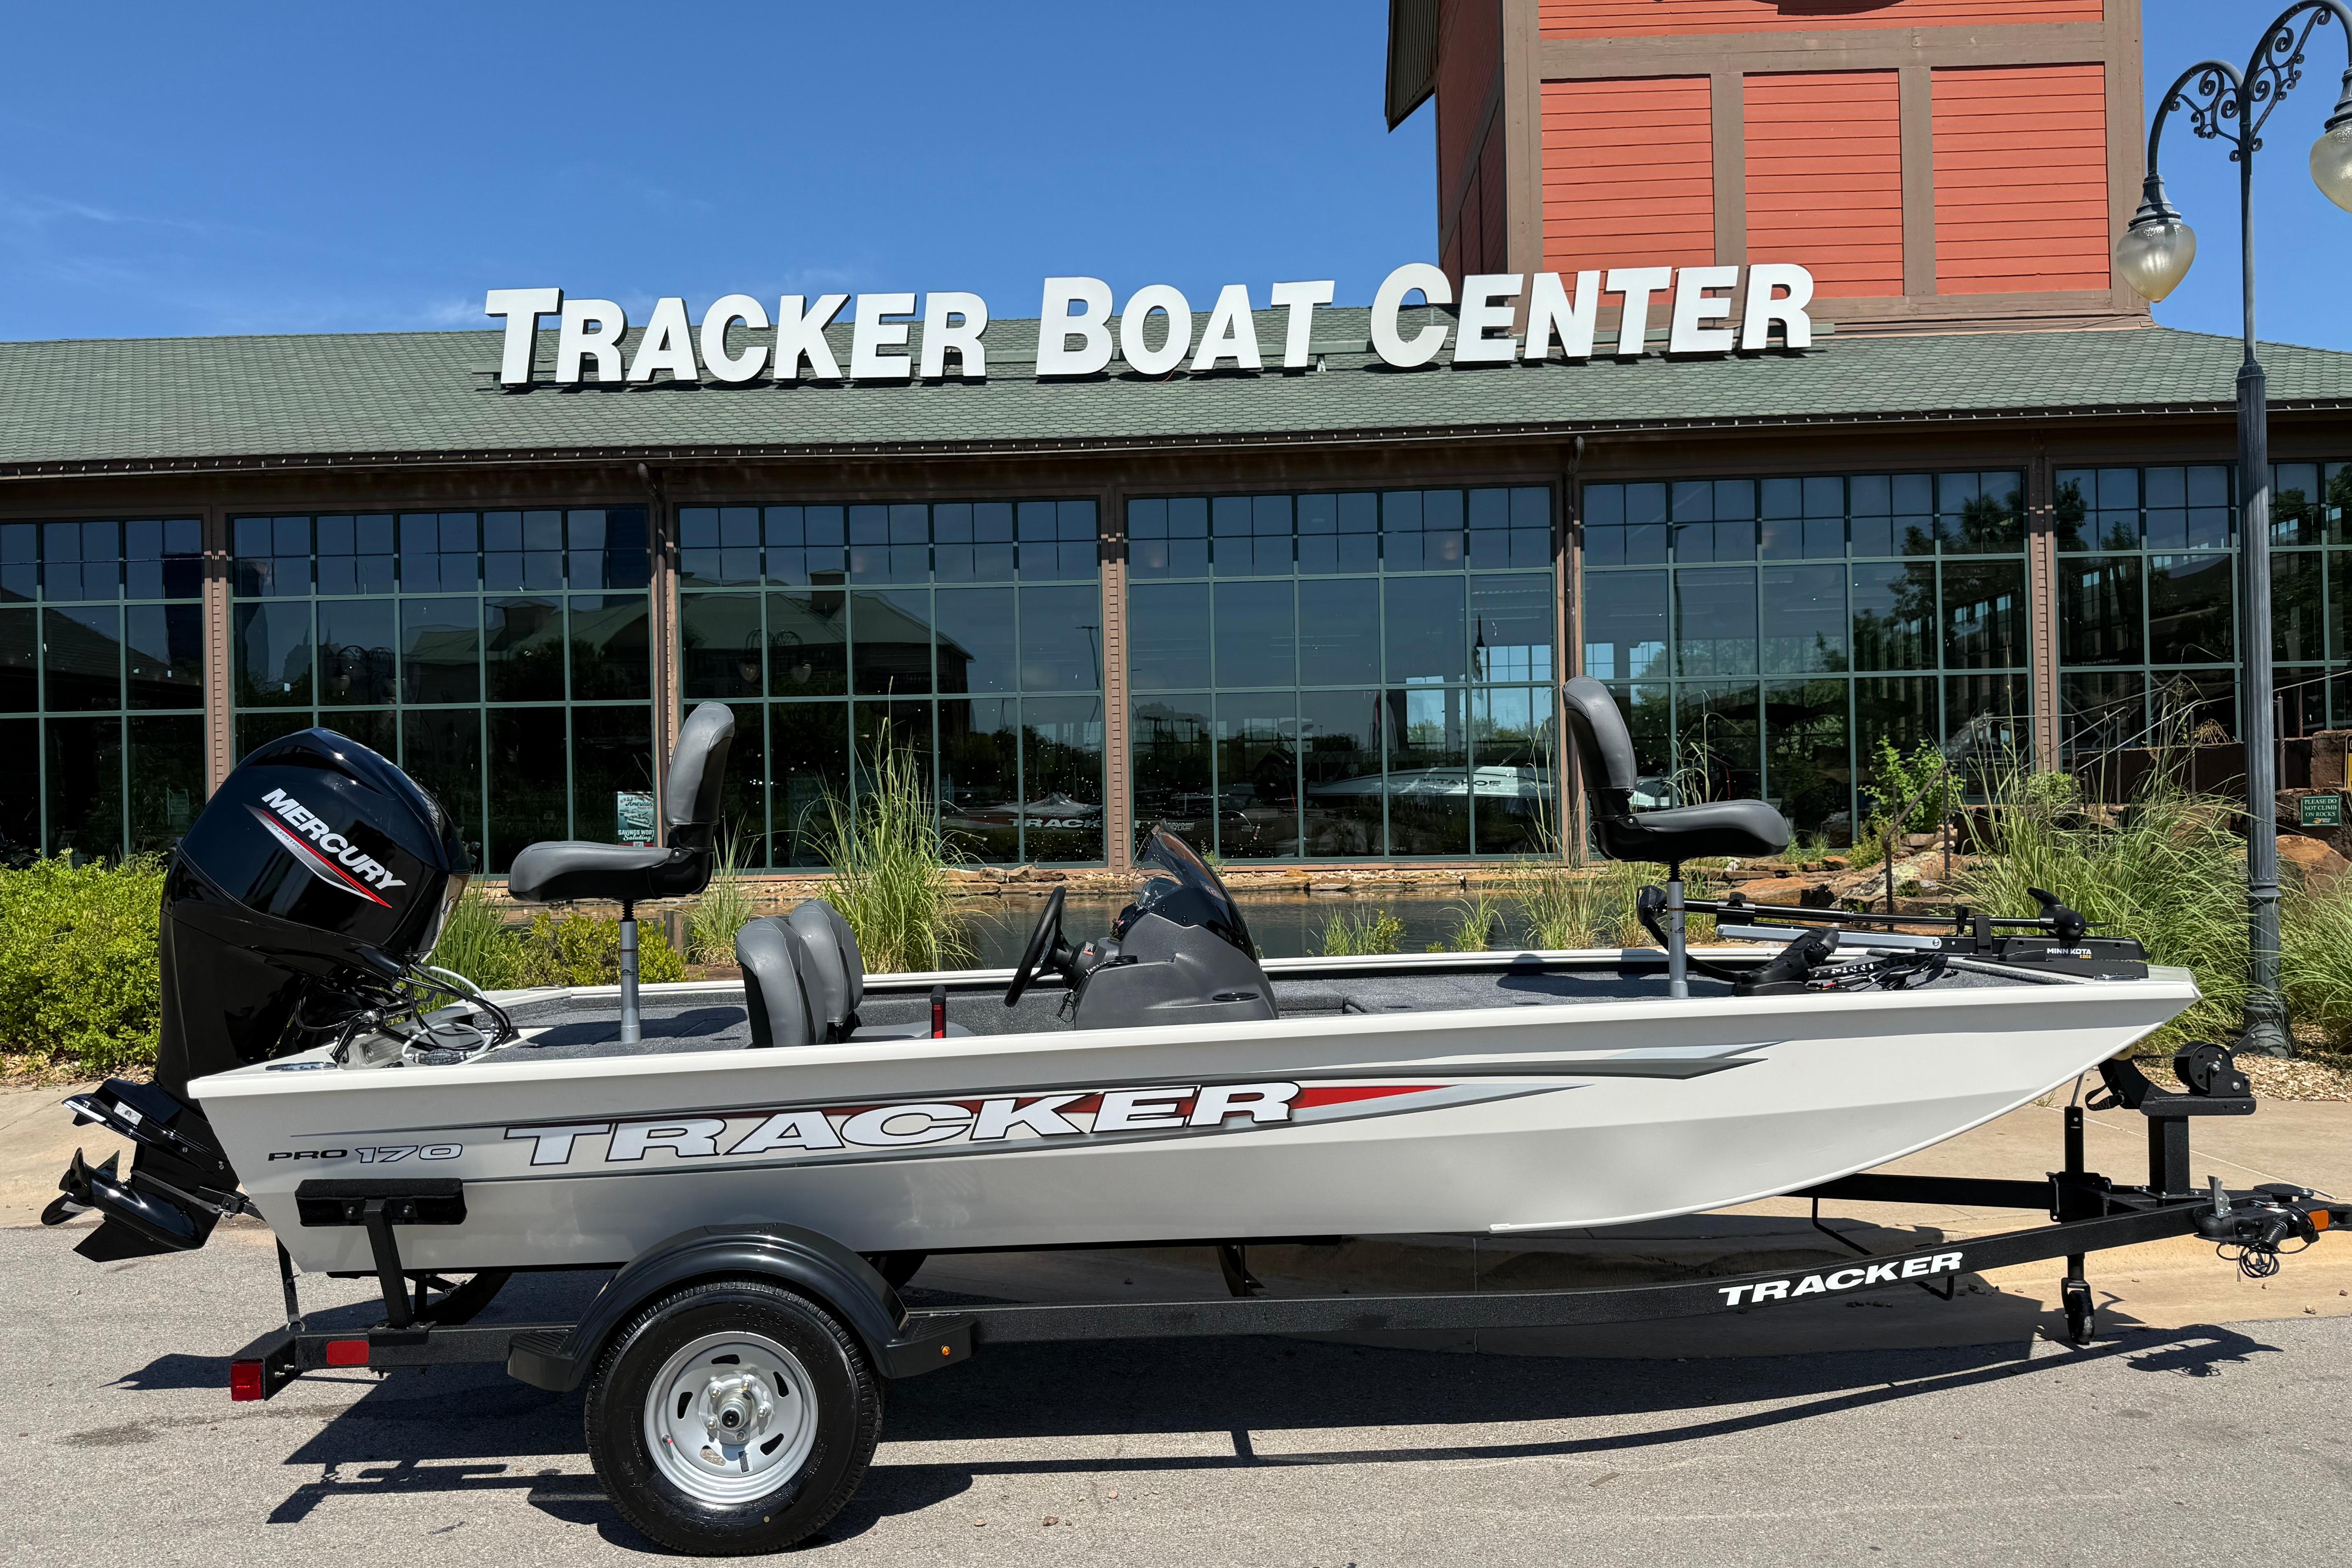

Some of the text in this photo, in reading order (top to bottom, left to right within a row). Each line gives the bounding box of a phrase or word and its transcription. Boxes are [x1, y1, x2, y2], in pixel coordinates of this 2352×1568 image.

[484, 263, 1814, 383] TRACKER BOAT CENTER
[261, 788, 407, 890] MERCURY
[623, 834, 654, 842] Saluting!
[268, 1143, 463, 1164] PRO 170
[504, 1080, 1300, 1167] TRACKER
[1718, 1251, 1963, 1306] TRACKER
